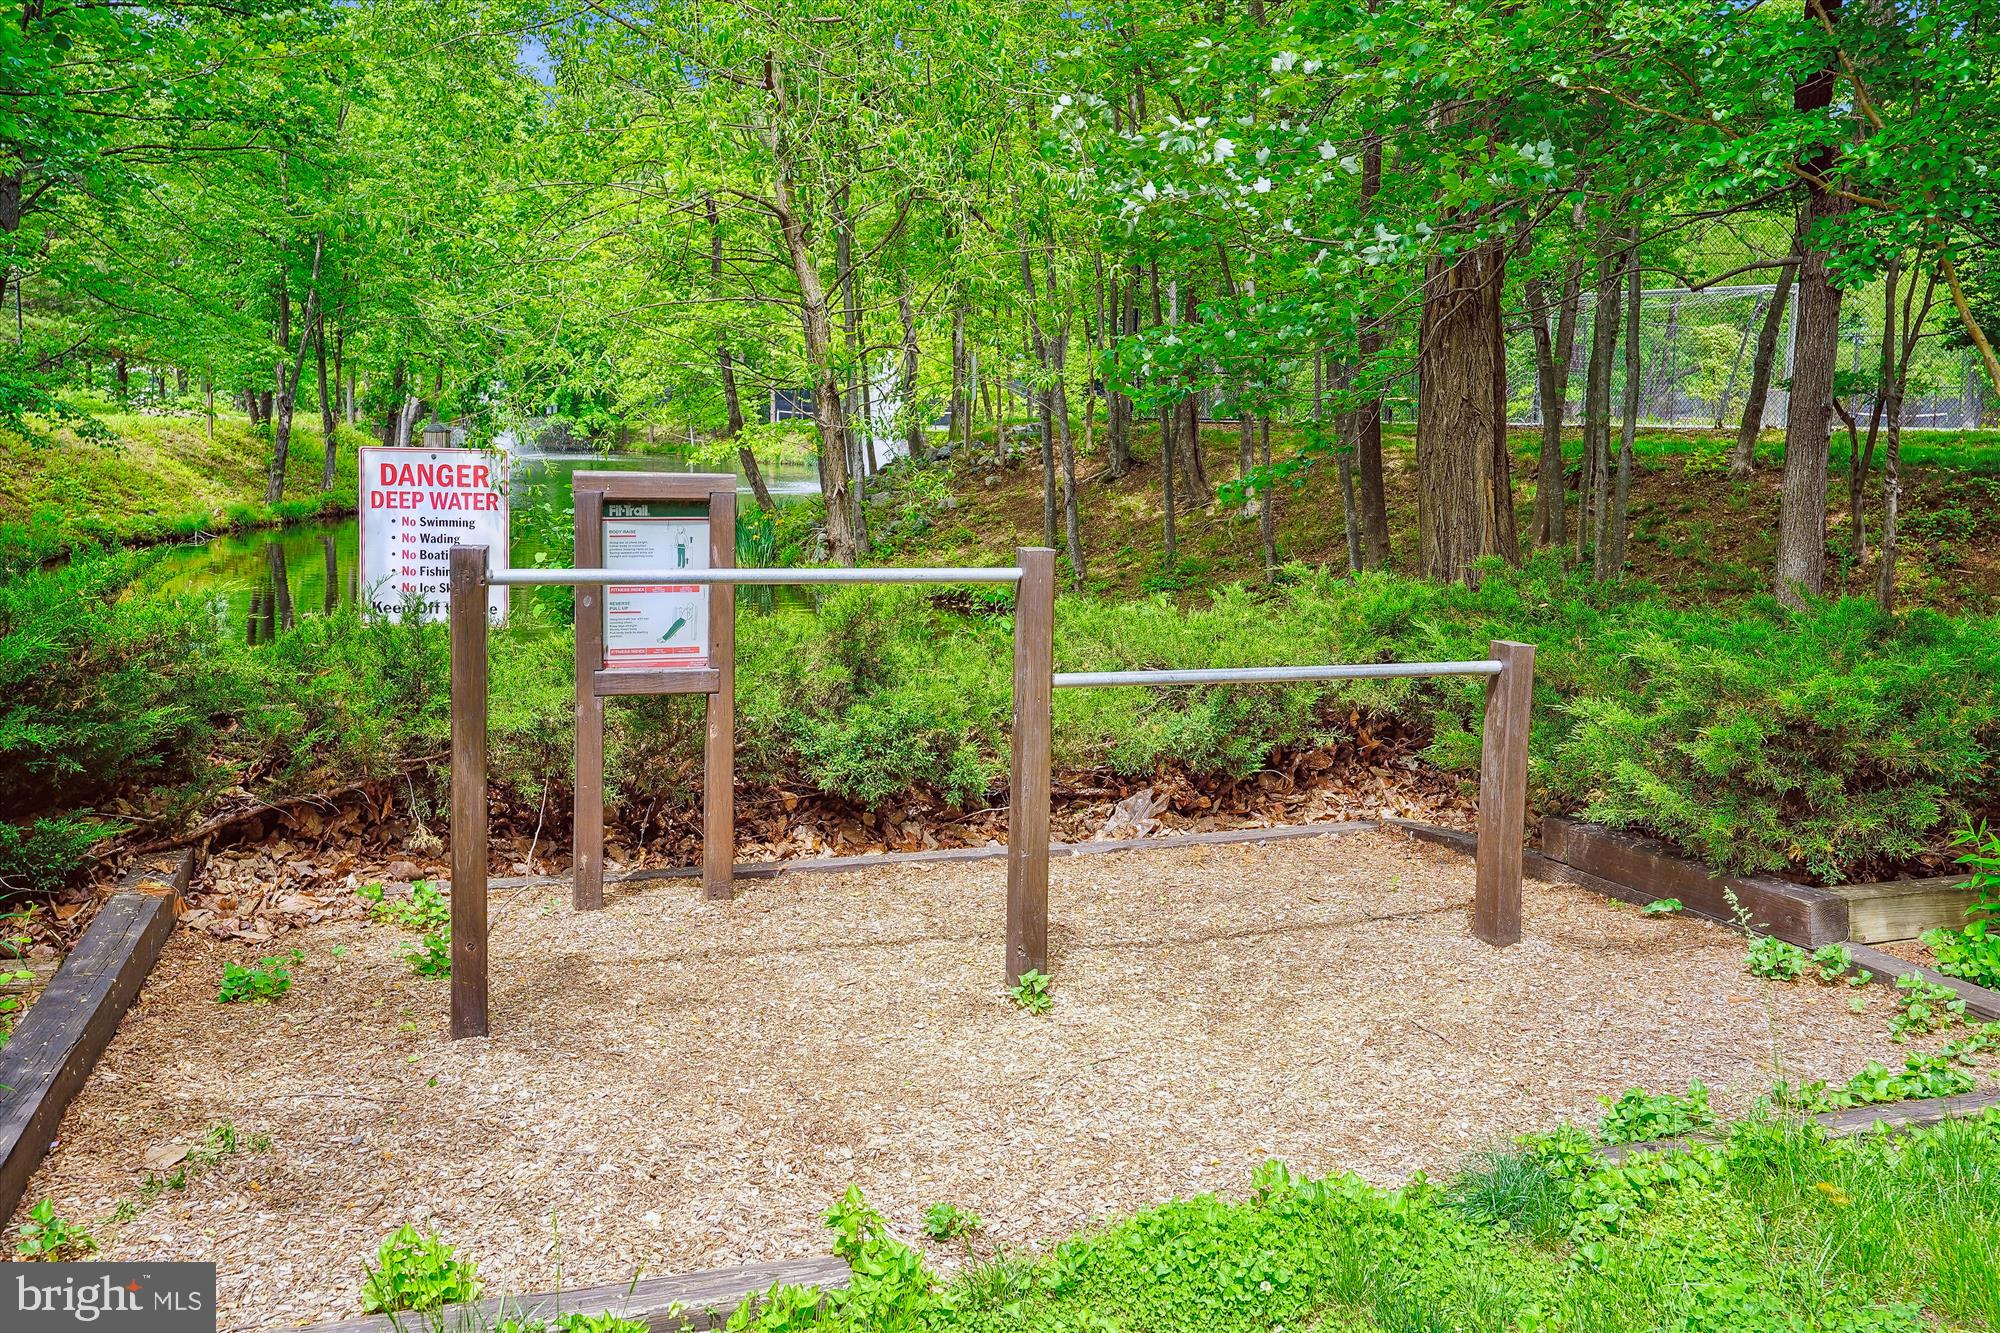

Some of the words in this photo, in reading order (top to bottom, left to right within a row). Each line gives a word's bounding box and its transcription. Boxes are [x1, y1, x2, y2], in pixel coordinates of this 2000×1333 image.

[380, 463, 490, 488] DANGER
[371, 490, 425, 509] DEEP
[429, 491, 499, 511] WATER
[401, 516, 416, 527] No
[419, 516, 476, 530] Swimming
[401, 533, 416, 543] No
[419, 533, 460, 545] Wading
[401, 549, 416, 560] No
[419, 549, 449, 560] Boati
[401, 566, 416, 576] No
[419, 566, 451, 577] Fishin
[401, 582, 416, 592] No
[419, 582, 436, 593] Ice
